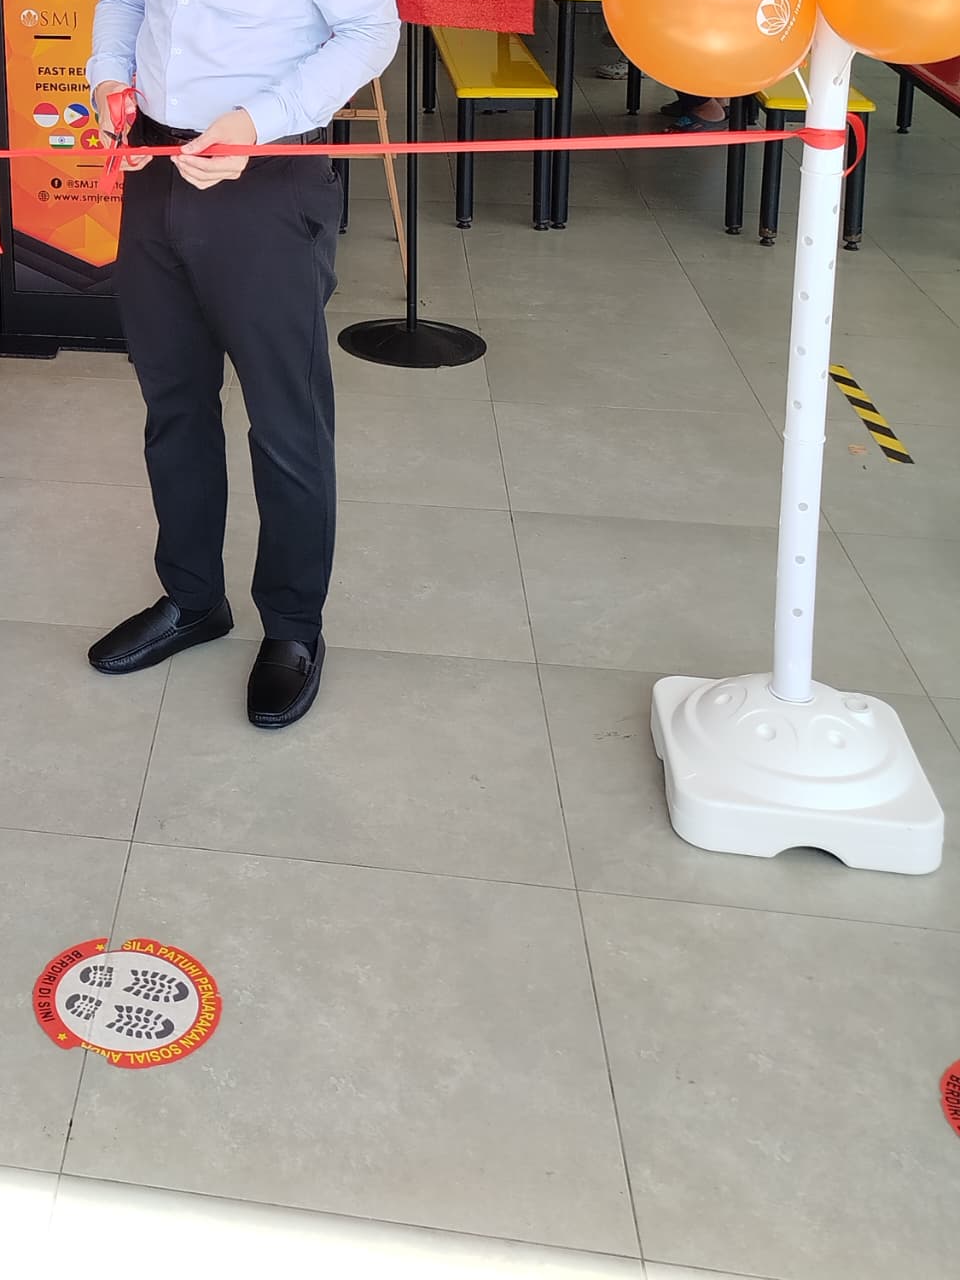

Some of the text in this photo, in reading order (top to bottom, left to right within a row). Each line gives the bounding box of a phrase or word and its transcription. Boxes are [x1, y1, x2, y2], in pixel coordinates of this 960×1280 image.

[40, 10, 78, 29] SMJ
[38, 66, 66, 76] FAST
[122, 941, 154, 953] SILA
[157, 947, 203, 978] PATUHI
[38, 949, 83, 1023] BERDIRI DI SINI
[178, 976, 217, 1049] PENJARAKAN
[125, 1043, 182, 1065] SOSIAL
